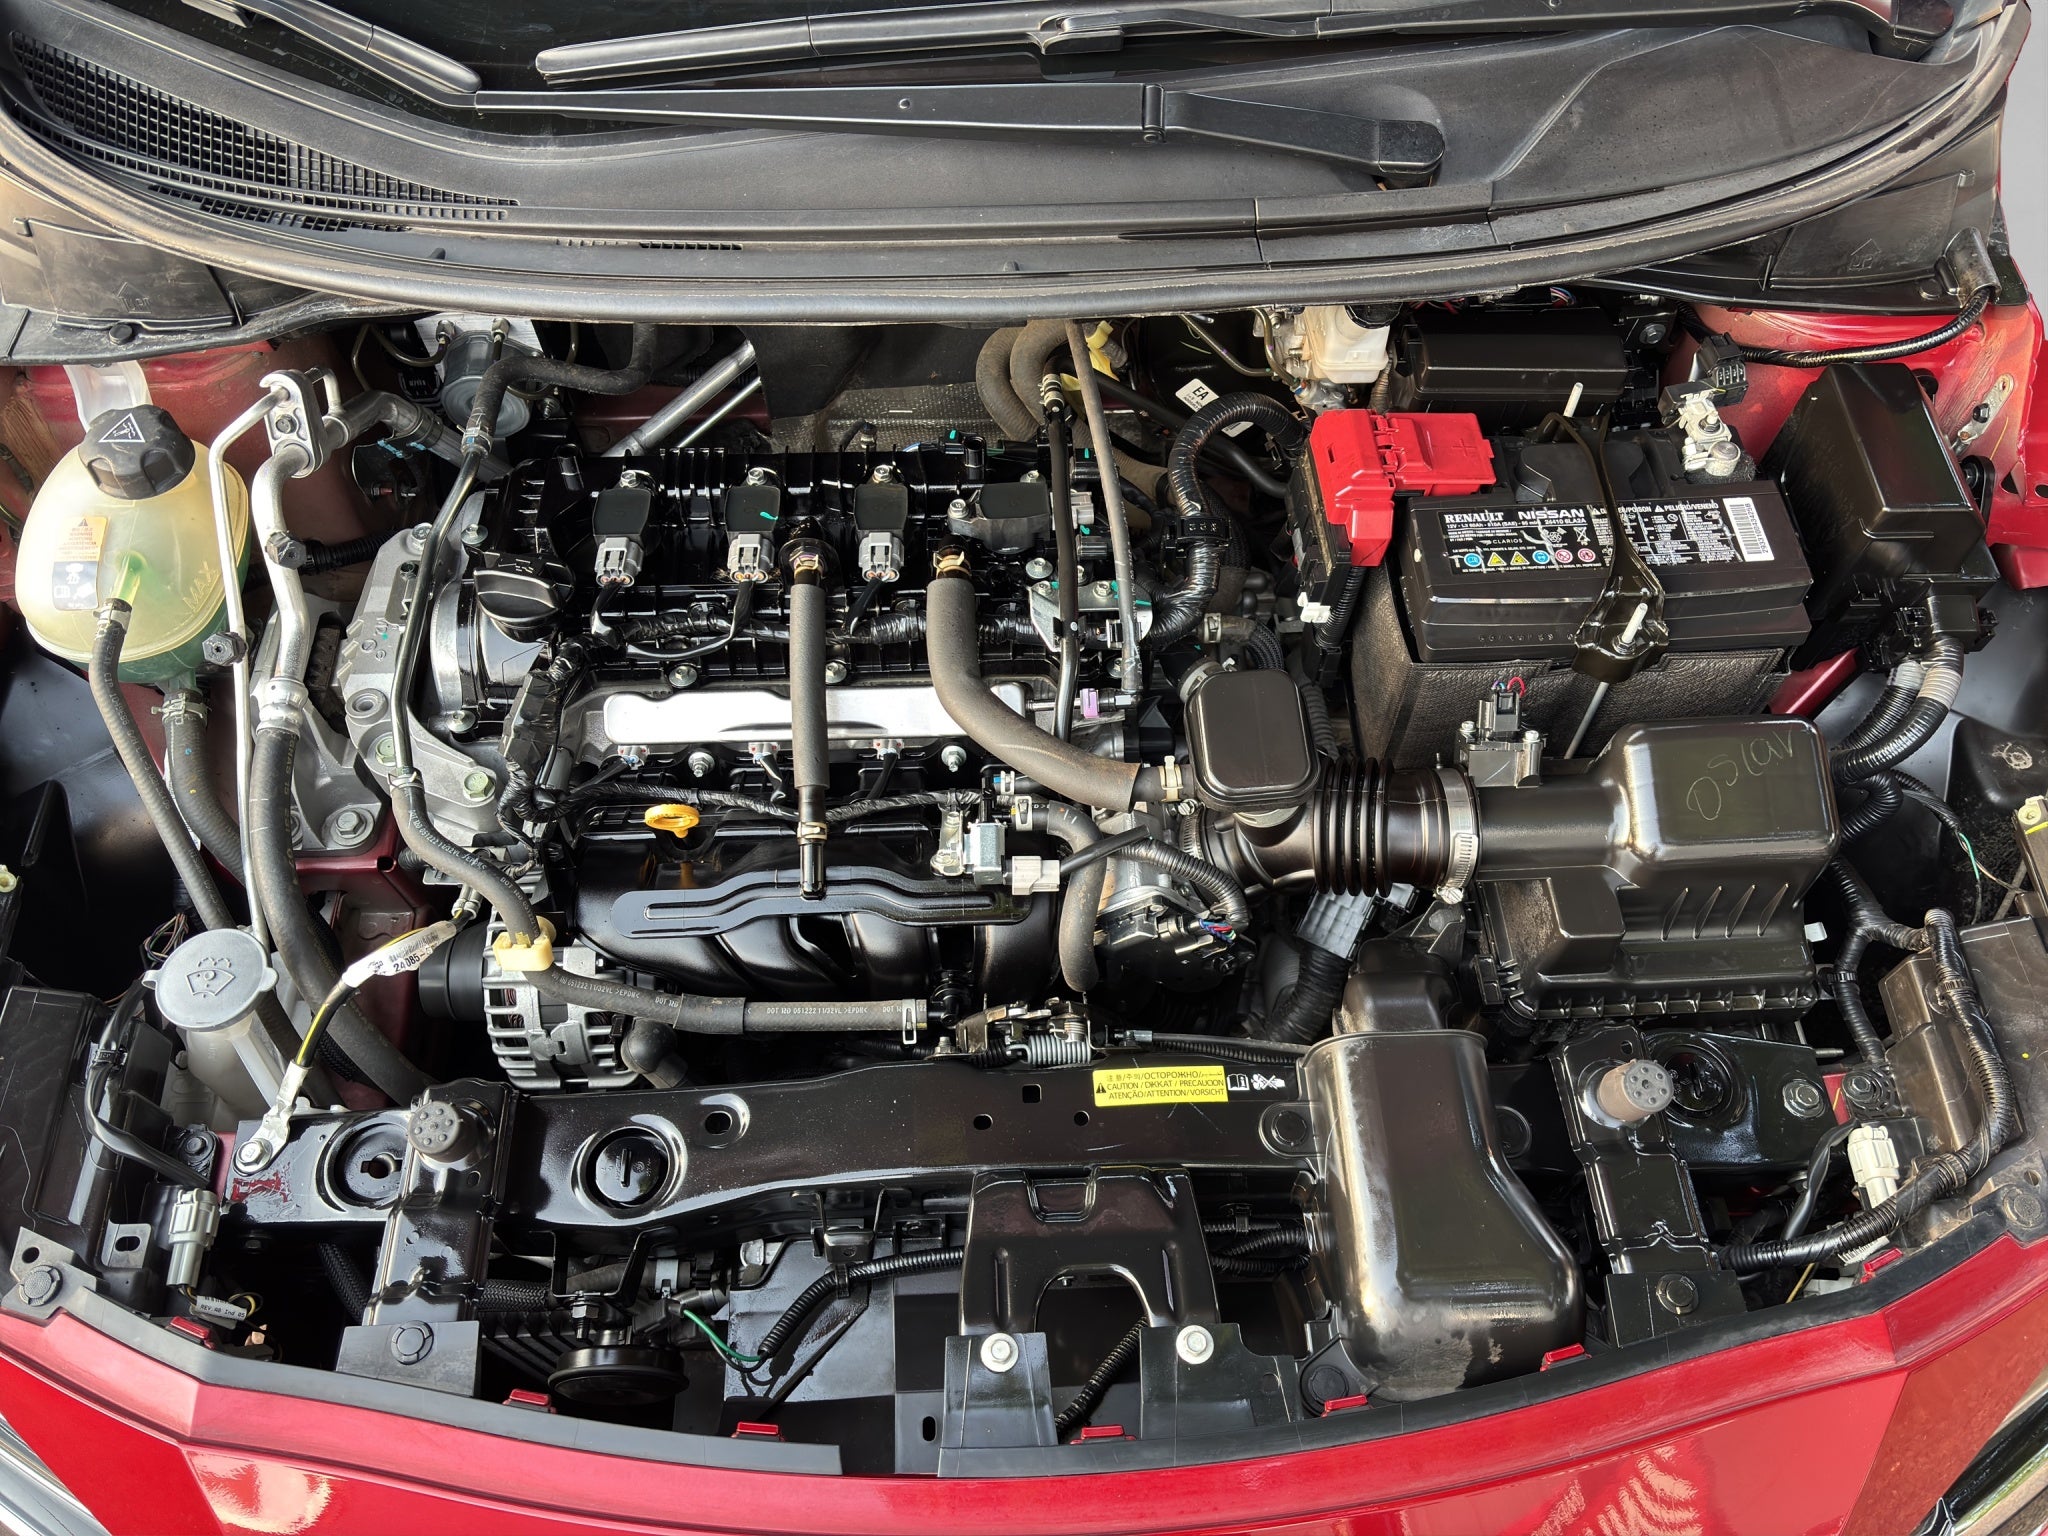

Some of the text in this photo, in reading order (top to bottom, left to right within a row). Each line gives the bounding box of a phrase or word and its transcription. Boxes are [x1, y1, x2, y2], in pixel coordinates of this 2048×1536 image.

[1192, 386, 1209, 401] EA
[1444, 508, 1585, 524] RENAULT NISSAN
[500, 877, 513, 889] DOT
[655, 996, 668, 1006] DOT
[766, 1007, 779, 1015] DOT
[793, 1007, 817, 1015] 051222
[1106, 1082, 1139, 1091] CAUTION
[1145, 1080, 1172, 1089] DIKKAT
